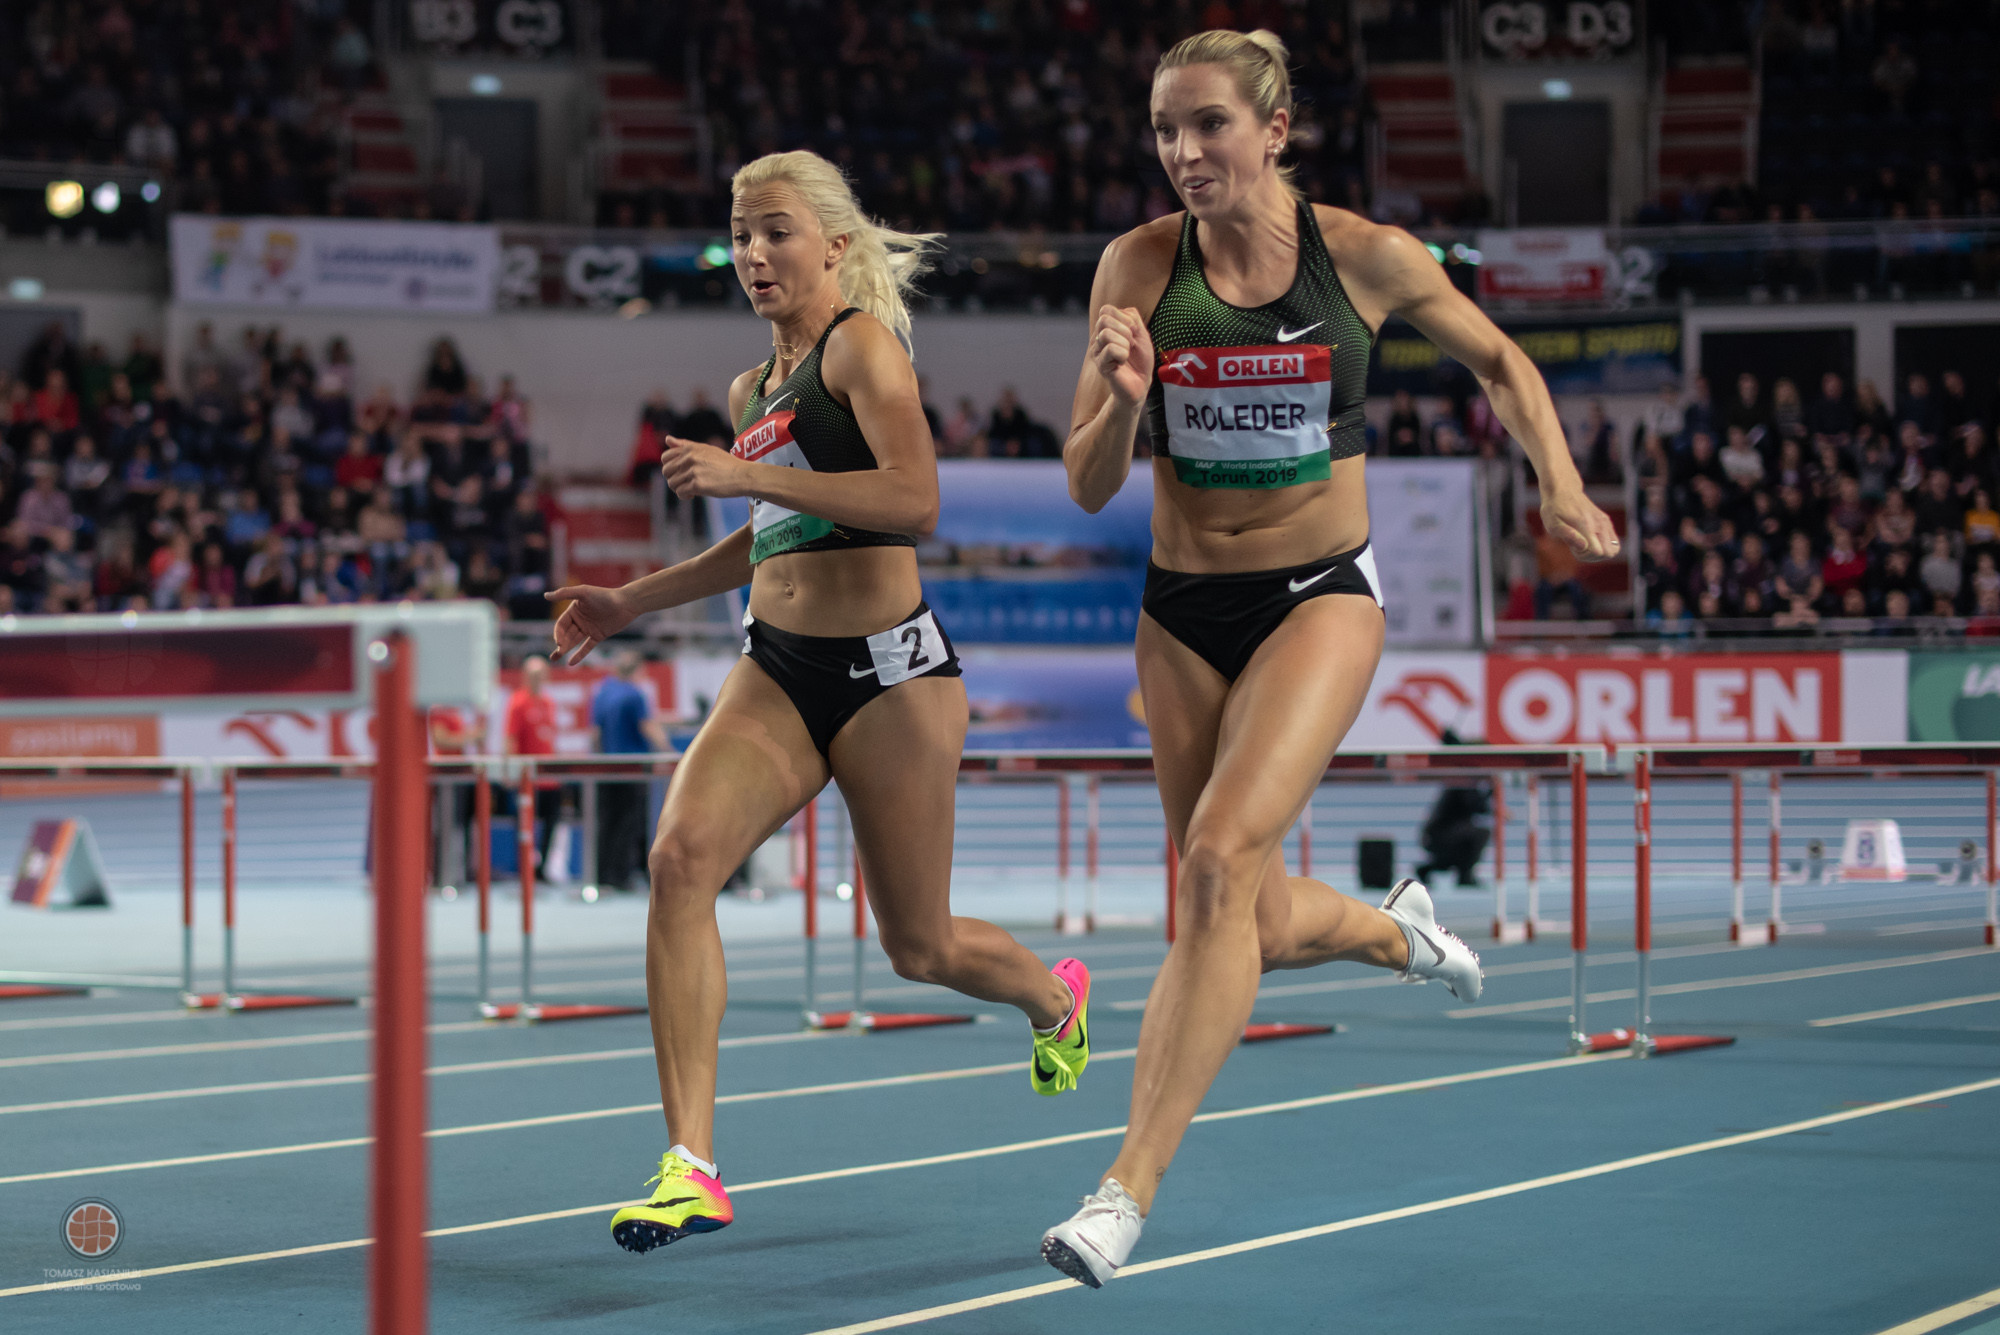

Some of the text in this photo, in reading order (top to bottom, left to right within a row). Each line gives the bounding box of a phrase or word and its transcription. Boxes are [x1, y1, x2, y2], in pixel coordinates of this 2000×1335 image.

[496, 0, 562, 46] C3
[1483, 2, 1547, 49] C3
[1568, 1, 1632, 46] D3
[565, 246, 640, 297] C2
[1222, 357, 1299, 378] ORLEN
[1184, 403, 1306, 432] ROLEDER
[745, 424, 775, 454] ORLEN
[1195, 459, 1299, 470] IAAF World Indoor Tour
[1201, 468, 1297, 484] Toruń 2019
[777, 525, 802, 546] 2019
[901, 626, 930, 671] 2
[1498, 667, 1821, 744] ORLEN
